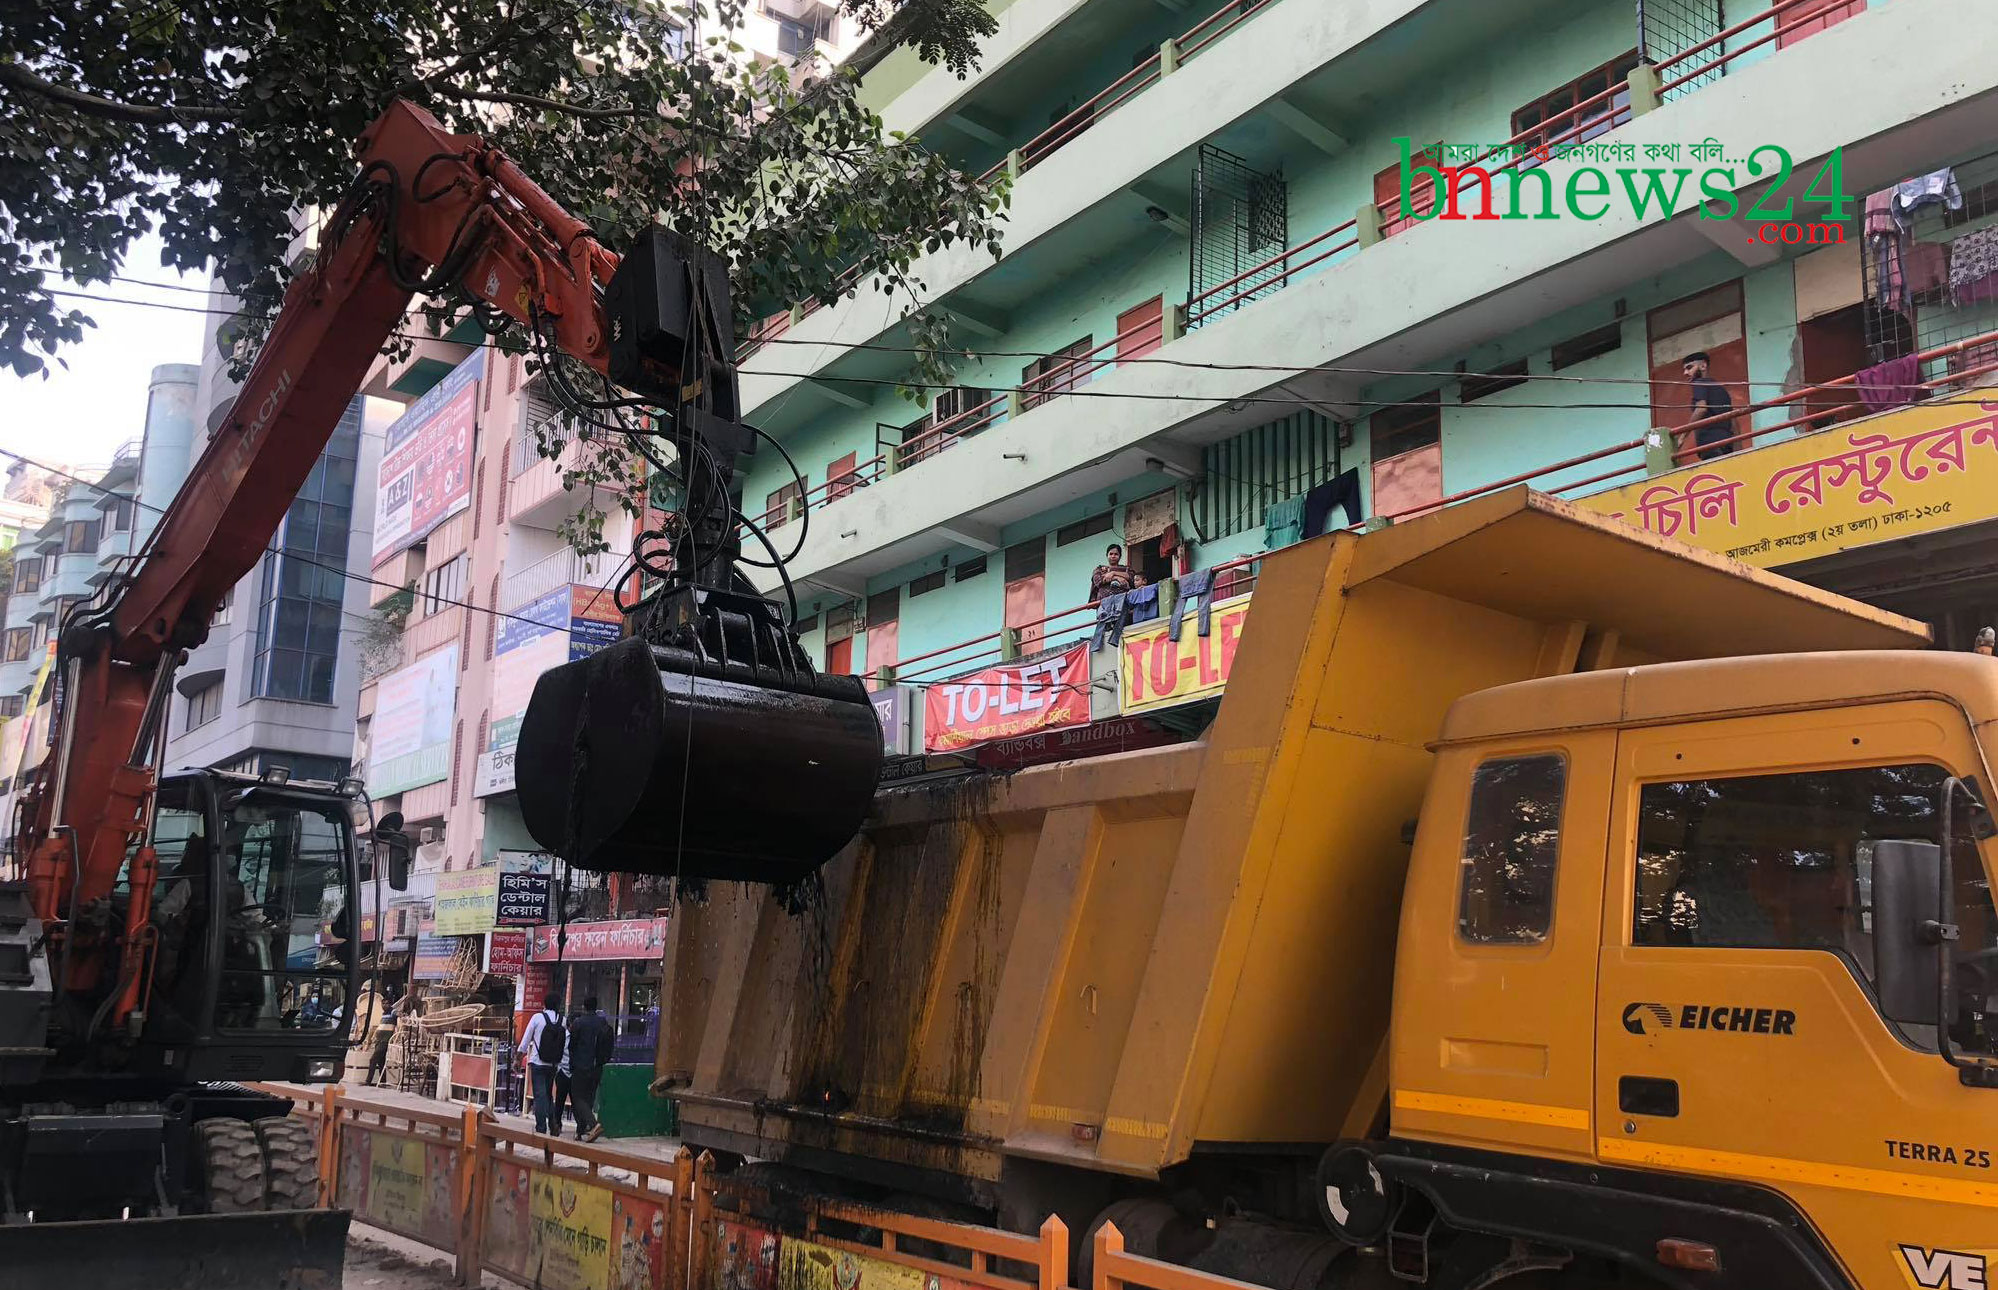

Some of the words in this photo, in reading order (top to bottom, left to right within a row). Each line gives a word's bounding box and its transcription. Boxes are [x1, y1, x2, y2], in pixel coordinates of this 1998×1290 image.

[222, 368, 291, 482] HITACHI
[1635, 473, 1744, 538] চিলি
[1882, 501, 1952, 525] ঢাকা-১২০৫
[1126, 610, 1249, 702] TO-LE
[943, 656, 1069, 726] TO-LET
[492, 751, 516, 771] ঠিক
[500, 890, 546, 904] ডেন্টাল
[501, 905, 543, 917] কেয়ার
[1680, 1005, 1796, 1035] EICHER
[1885, 1139, 1958, 1164] TERRA
[1963, 1149, 1990, 1168] 25
[1897, 1243, 1988, 1290] VE
